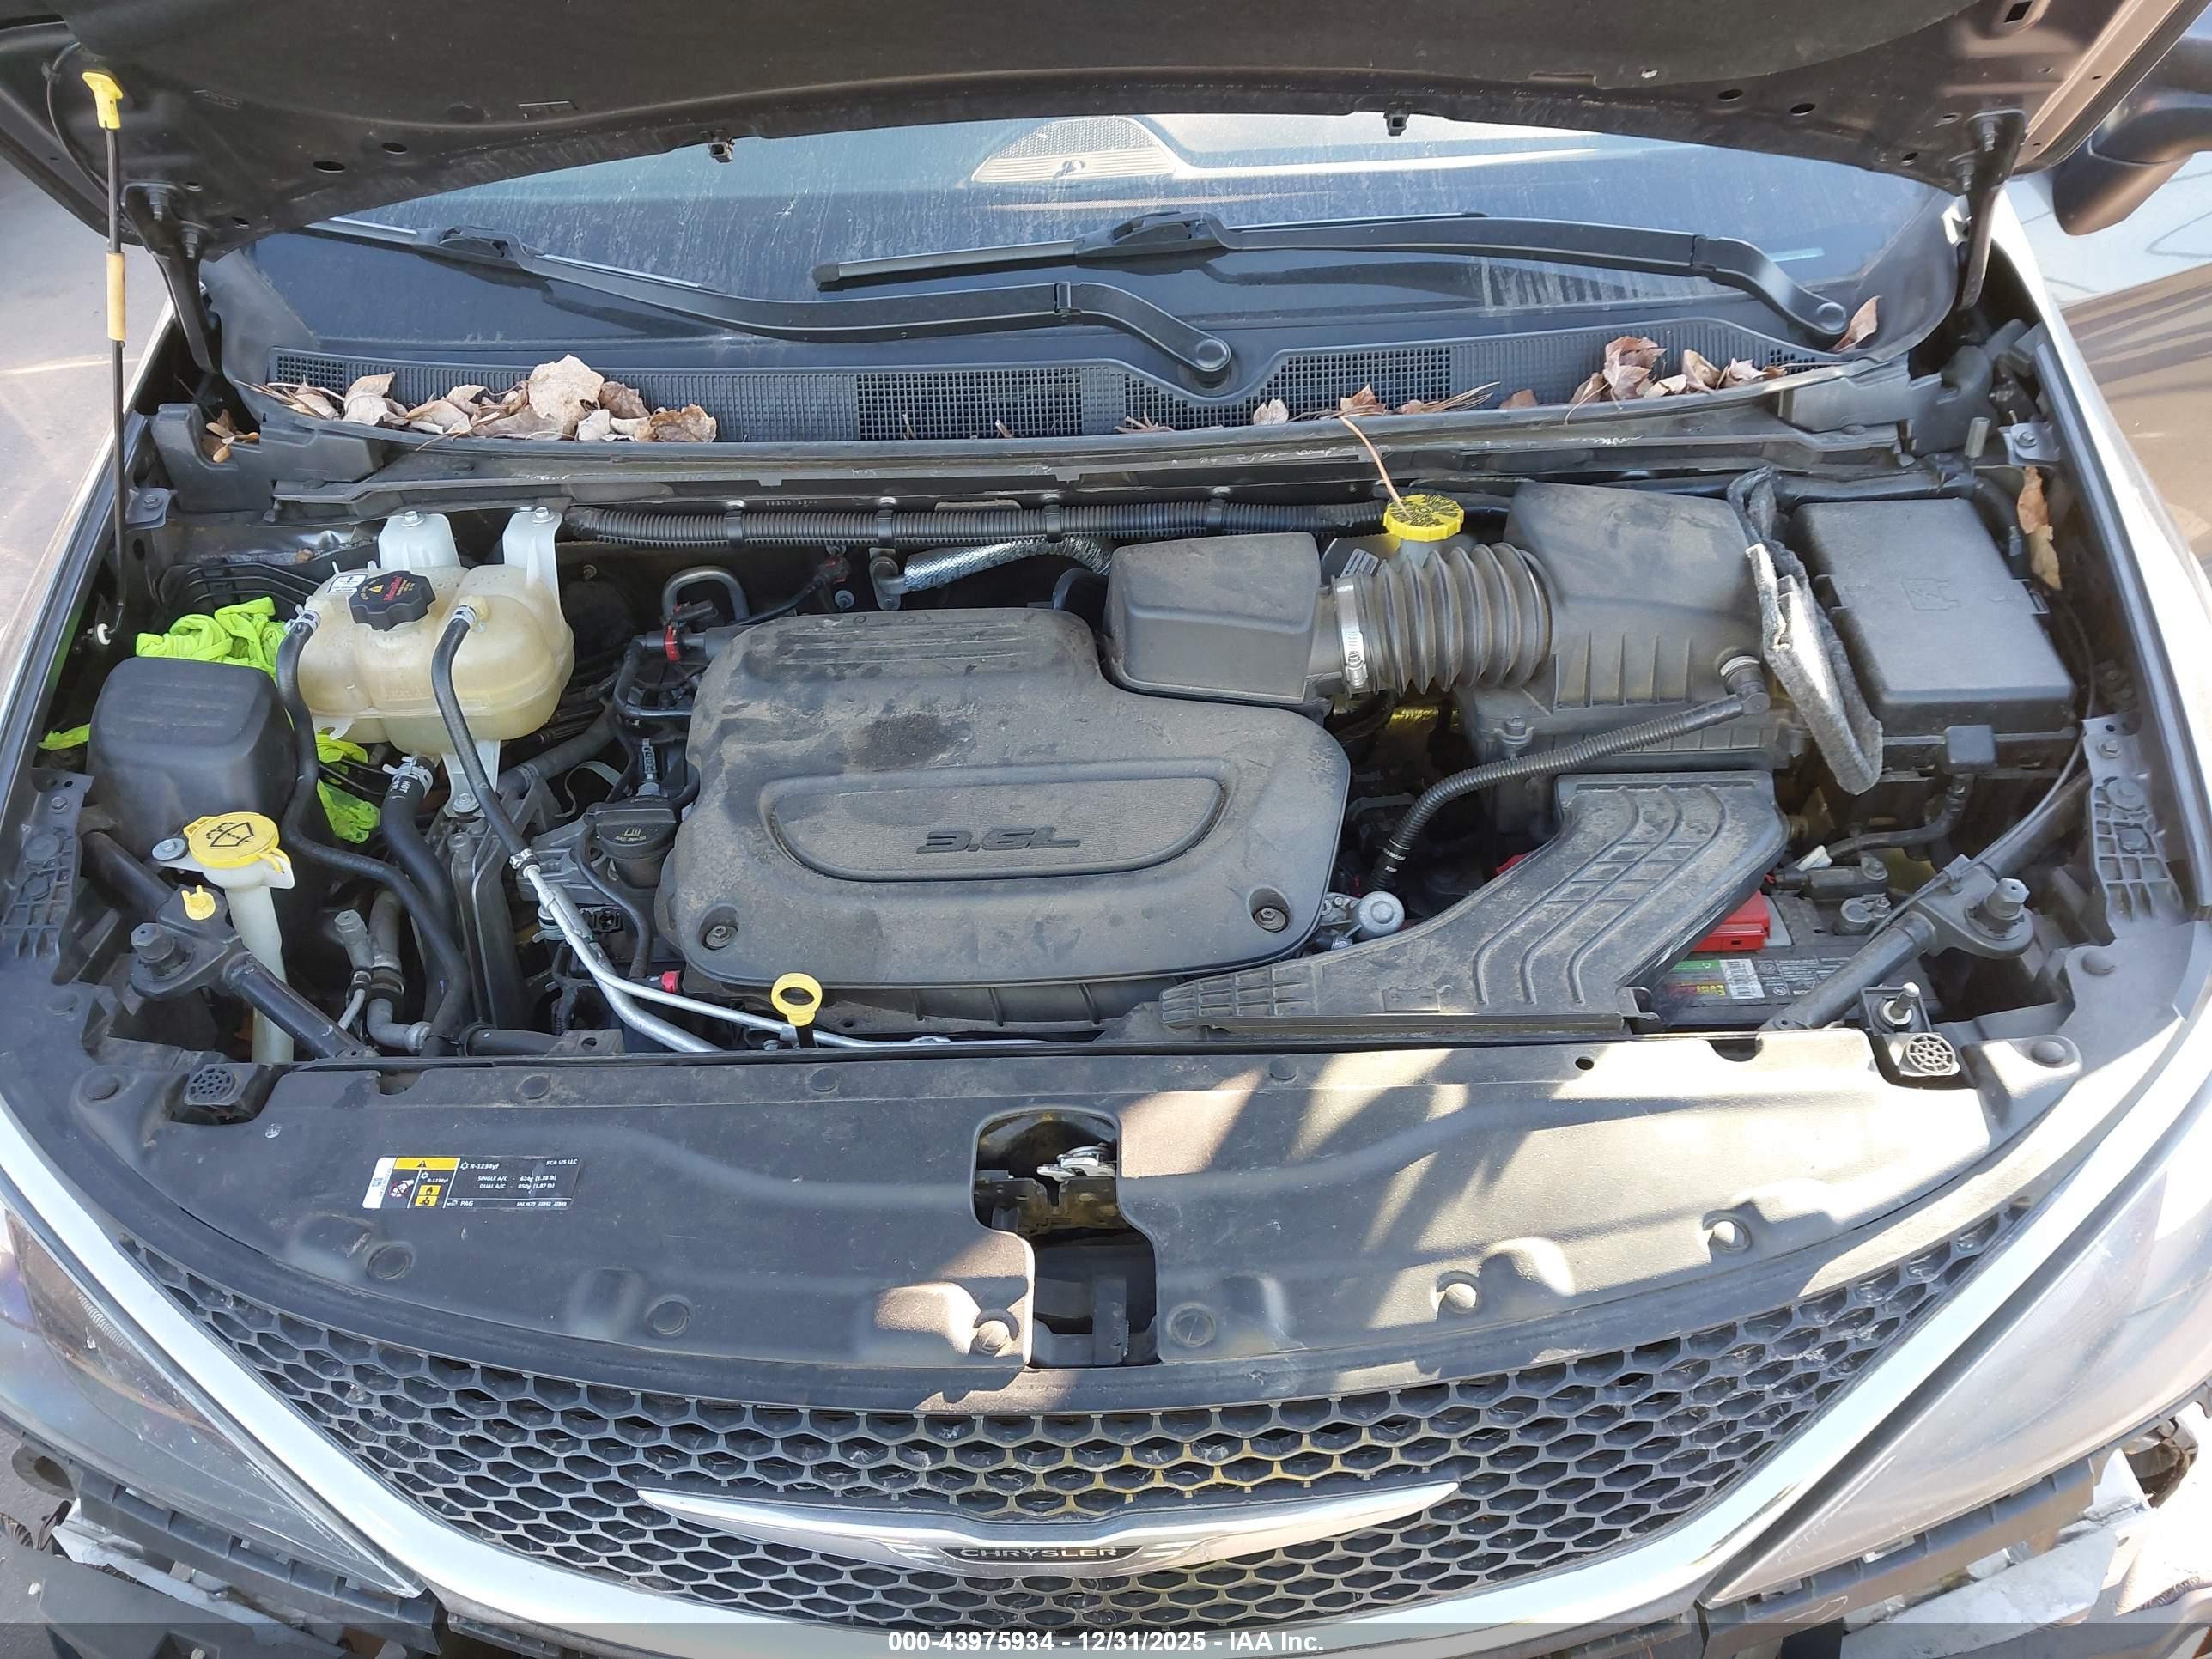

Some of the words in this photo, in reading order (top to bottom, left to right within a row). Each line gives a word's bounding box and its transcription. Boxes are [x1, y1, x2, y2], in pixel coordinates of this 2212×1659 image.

[398, 781, 411, 793] HOT
[915, 826, 1081, 854] 3.6L
[470, 1163, 500, 1171] R-1234yf
[960, 1547, 1118, 1560] CHRYSLER
